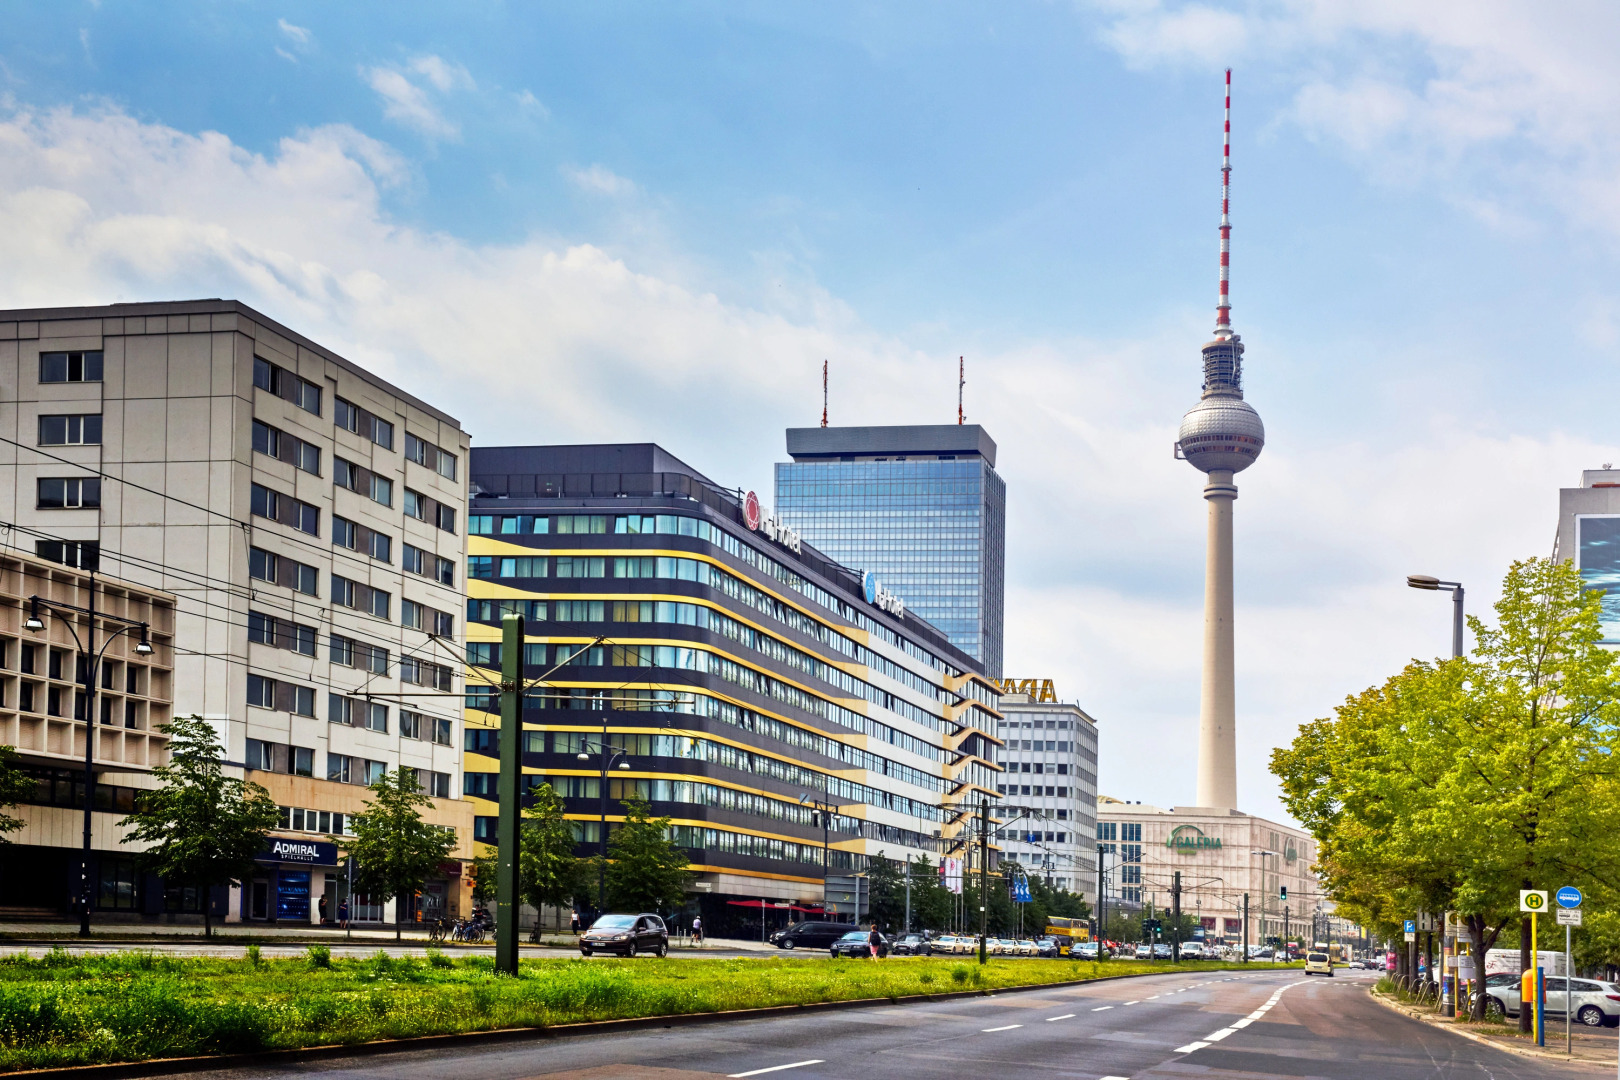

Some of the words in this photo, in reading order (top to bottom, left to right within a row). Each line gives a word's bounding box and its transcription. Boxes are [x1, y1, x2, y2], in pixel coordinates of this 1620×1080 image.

[1176, 836, 1222, 849] GALERIA
[273, 841, 320, 857] ADMIRAL
[1529, 896, 1540, 906] H
[1406, 922, 1413, 931] P
